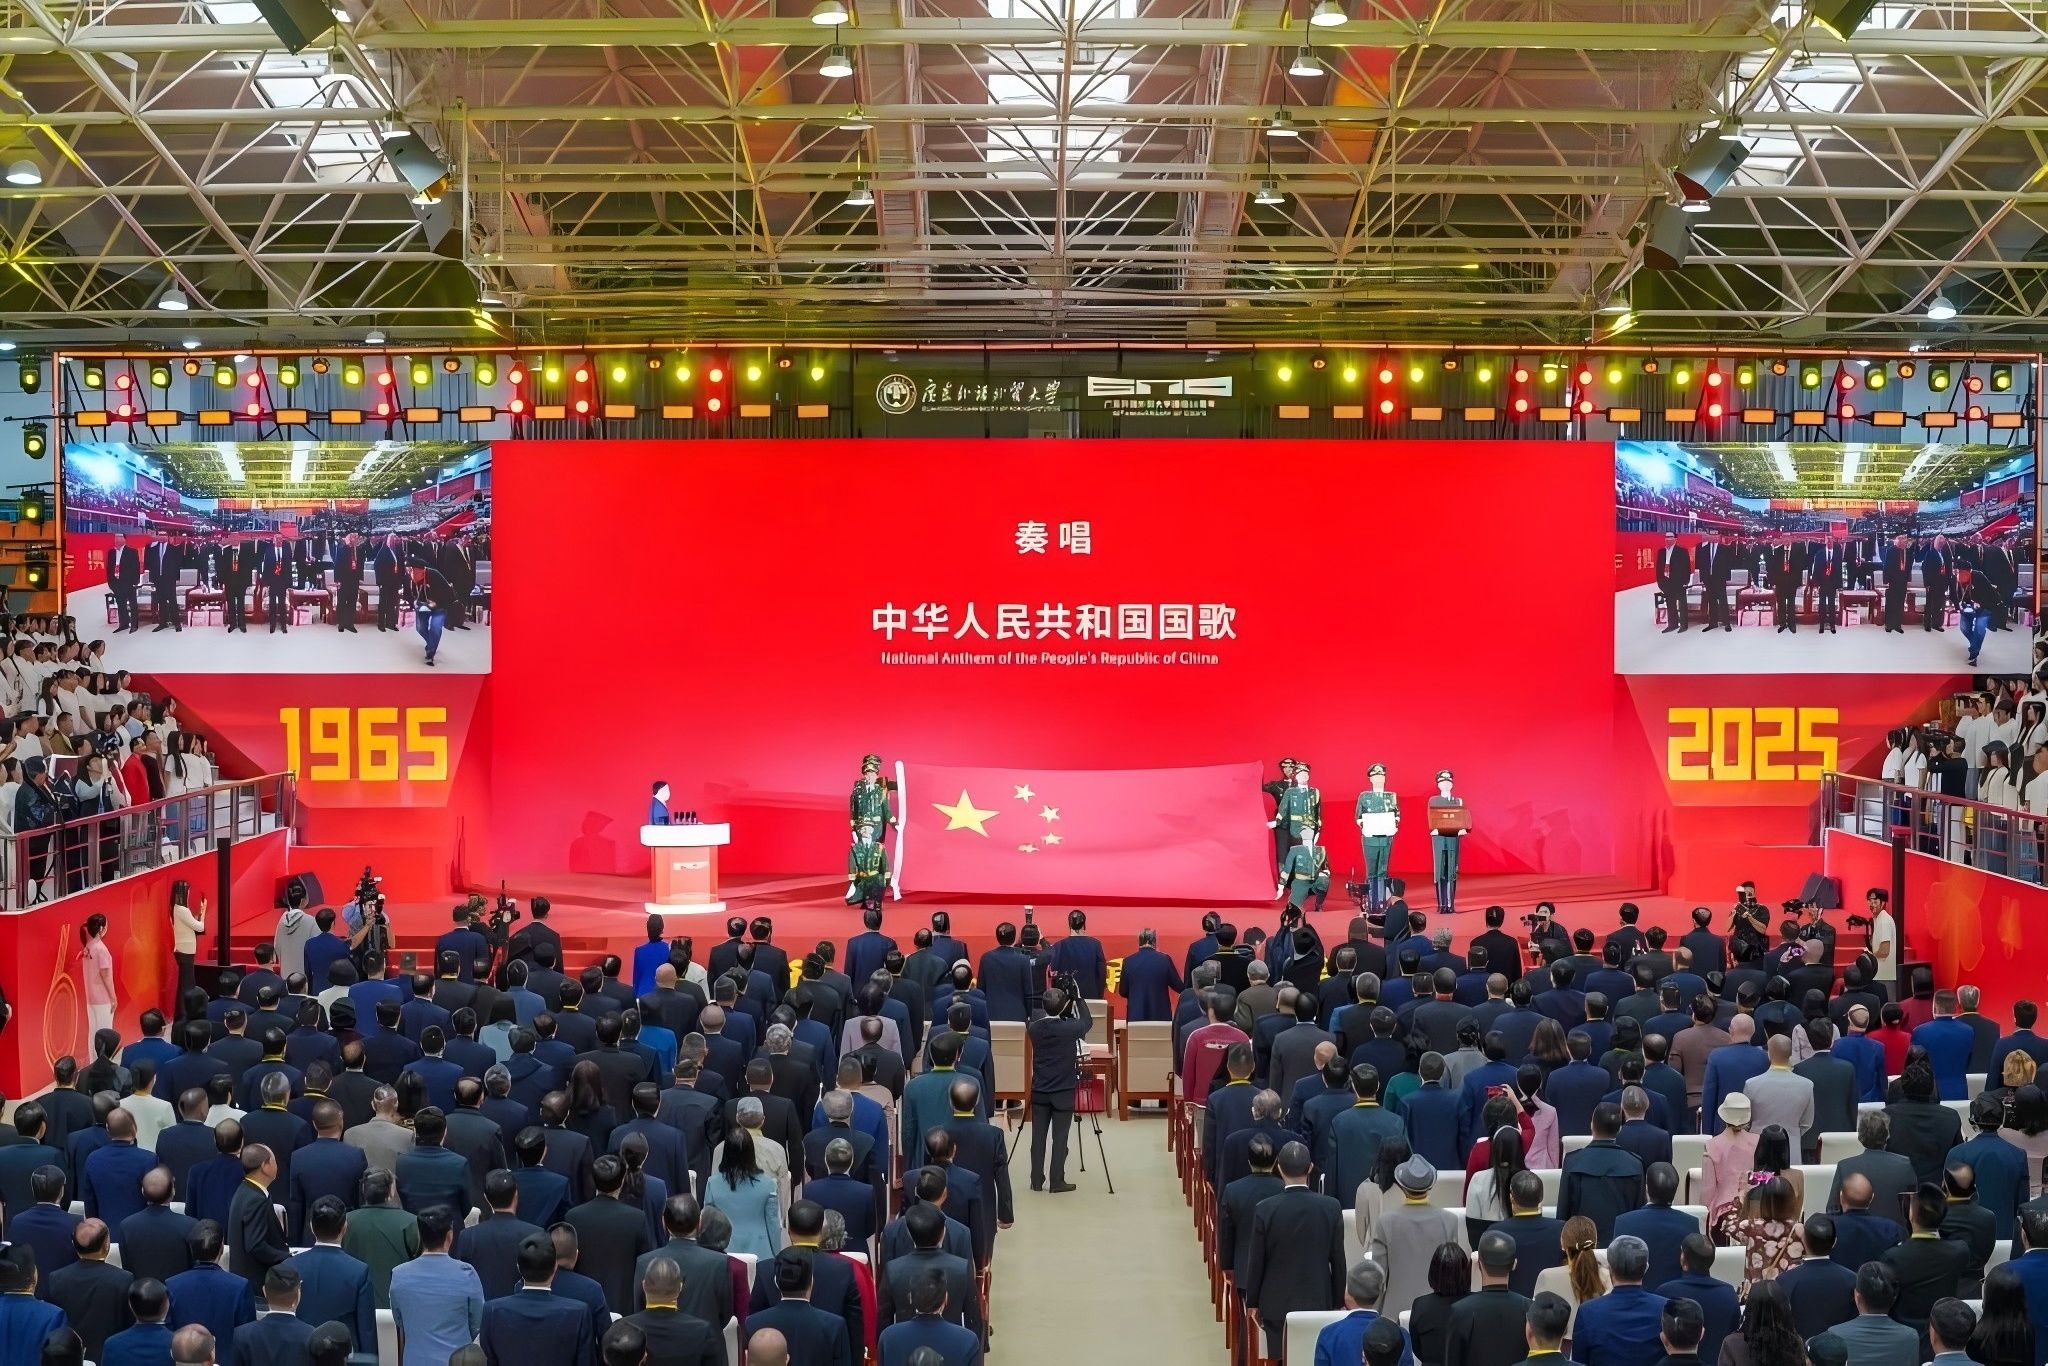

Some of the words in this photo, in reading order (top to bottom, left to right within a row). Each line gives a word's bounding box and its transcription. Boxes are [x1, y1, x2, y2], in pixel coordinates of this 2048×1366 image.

[1014, 519, 1092, 555] 奏唱
[872, 601, 1237, 641] 中华人民共和国国歌
[999, 651, 1012, 665] of
[1016, 651, 1038, 665] the
[1163, 651, 1177, 665] of
[279, 707, 448, 782] 1965
[1667, 707, 1839, 781] 2025
